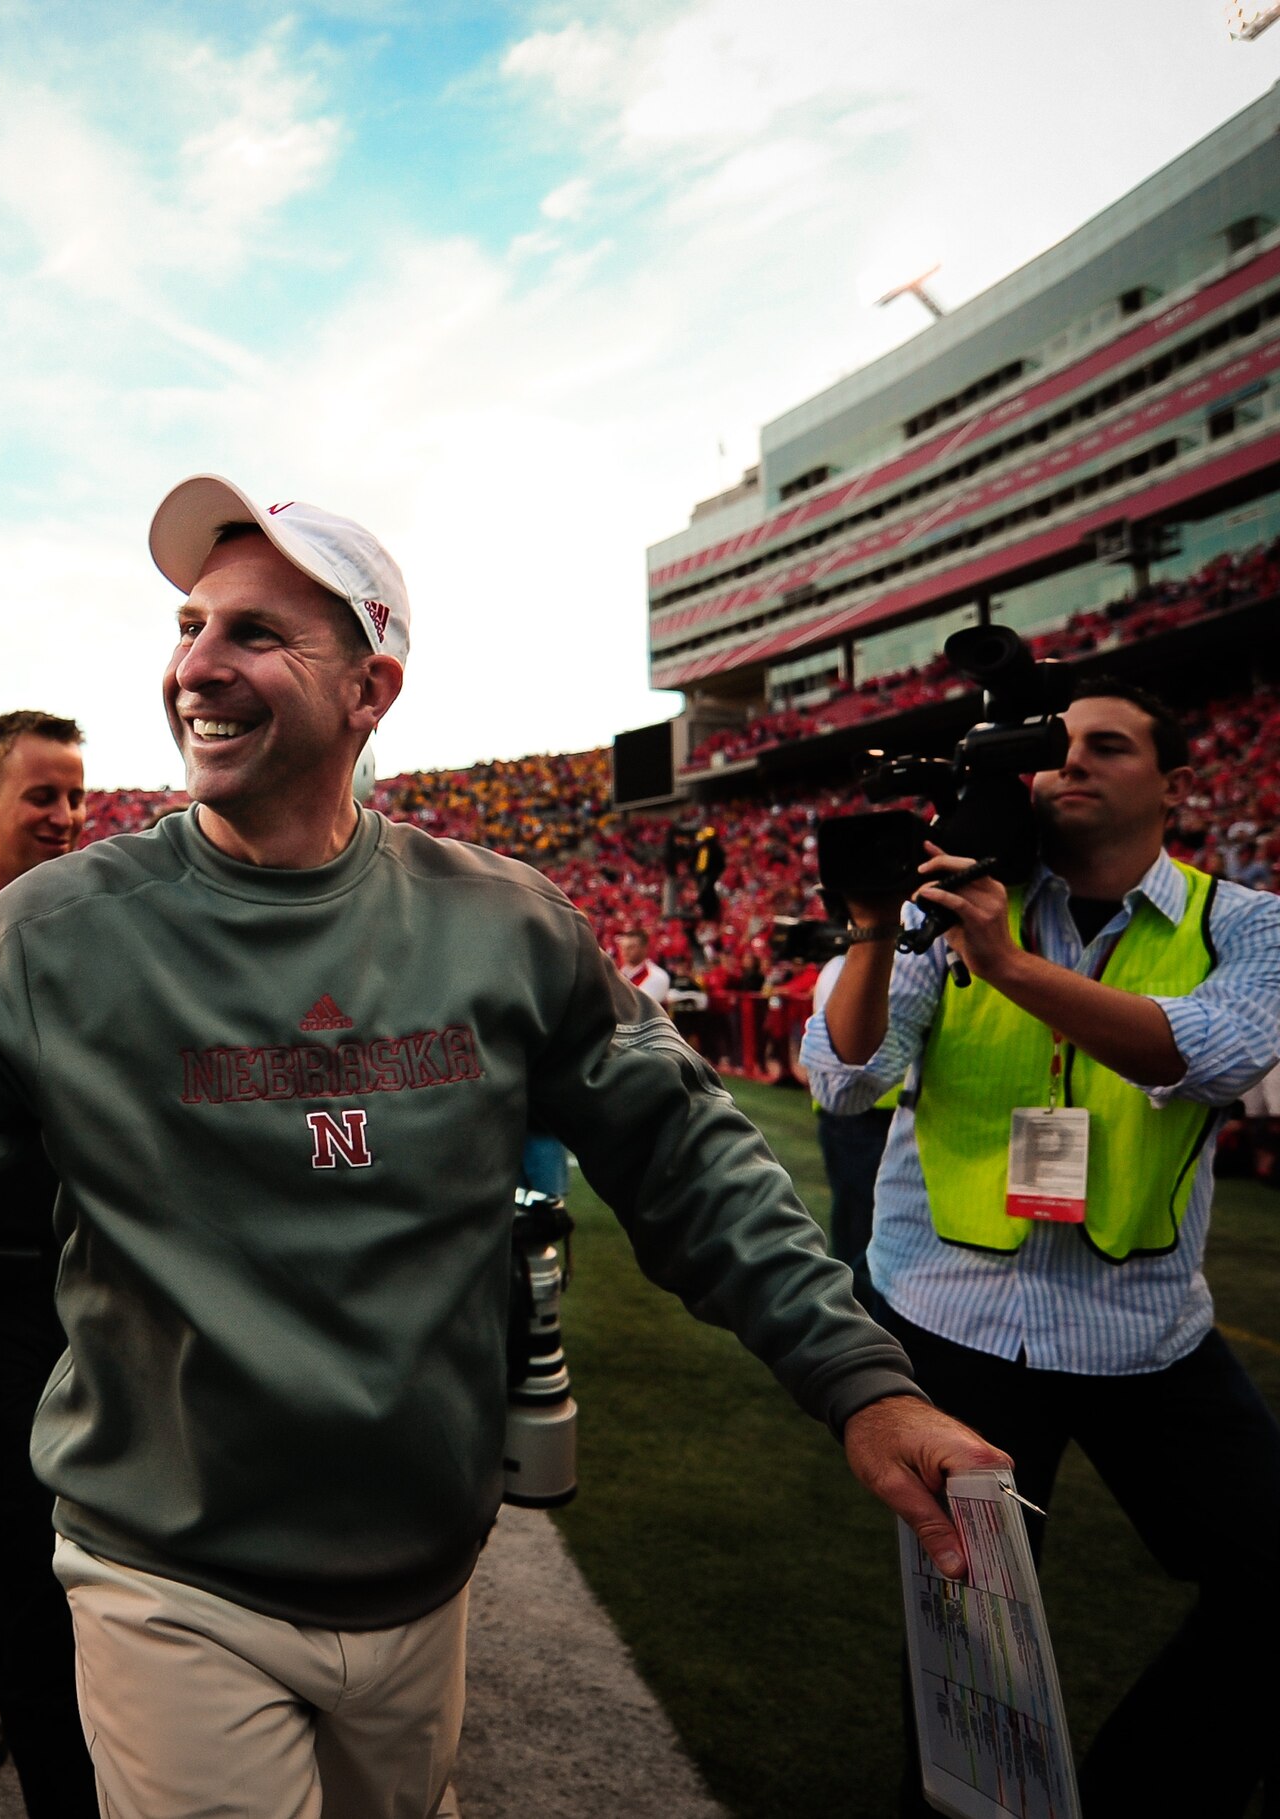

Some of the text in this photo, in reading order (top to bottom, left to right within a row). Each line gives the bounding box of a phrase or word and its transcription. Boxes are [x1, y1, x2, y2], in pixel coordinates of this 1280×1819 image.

[299, 1016, 353, 1031] adidas
[181, 1023, 481, 1103] NEBRASKA
[306, 1109, 372, 1168] N
